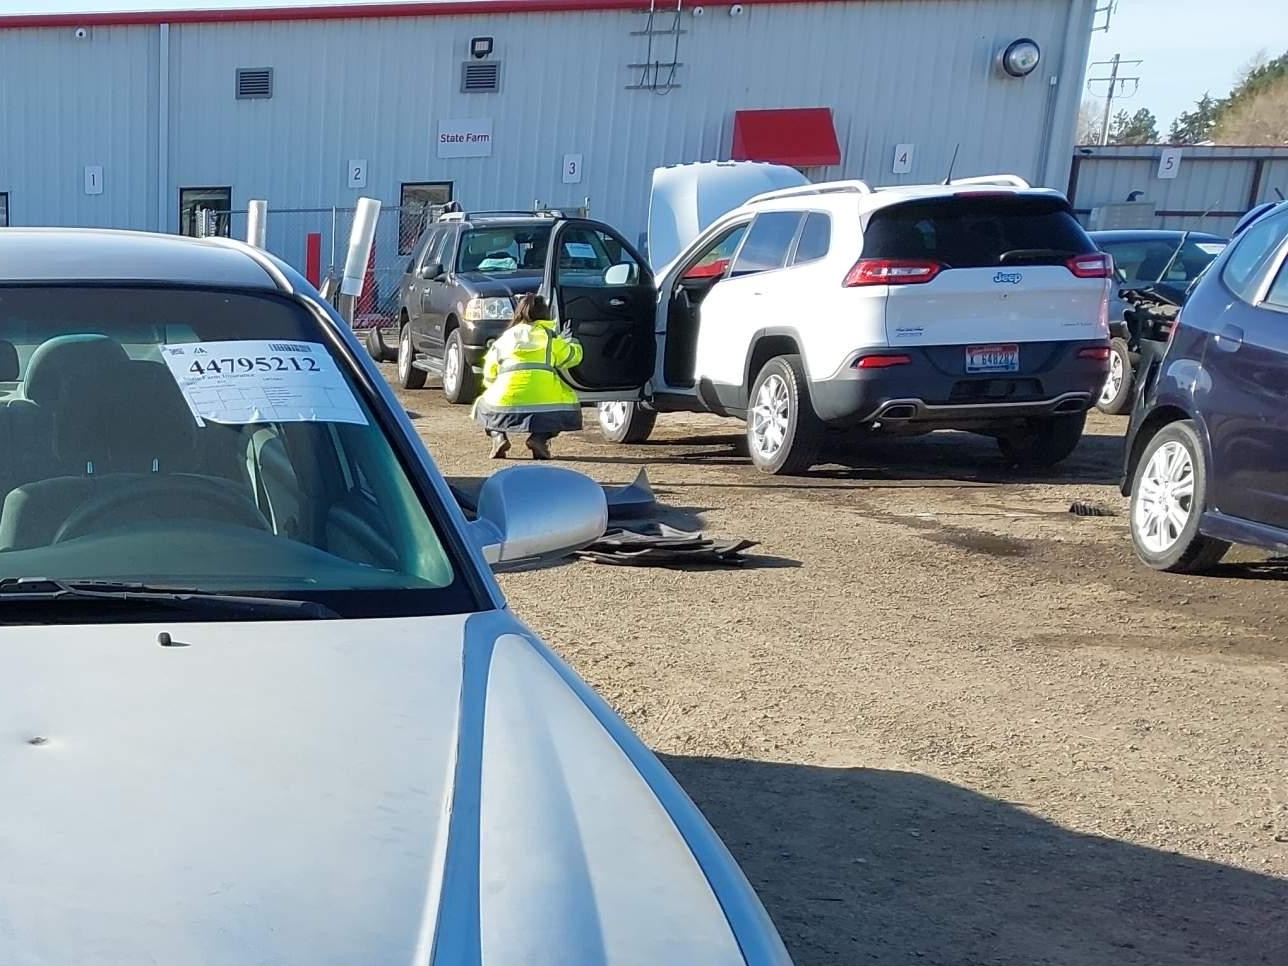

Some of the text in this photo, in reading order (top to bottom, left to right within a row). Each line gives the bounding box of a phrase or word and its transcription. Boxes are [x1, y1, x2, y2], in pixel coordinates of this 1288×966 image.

[440, 133, 490, 143] State Farm
[899, 151, 908, 165] 4
[1164, 156, 1175, 170] 5
[354, 167, 361, 180] 2
[568, 161, 576, 175] 3
[91, 173, 96, 186] 1
[993, 271, 1023, 285] Jeep
[189, 356, 321, 375] 44795212
